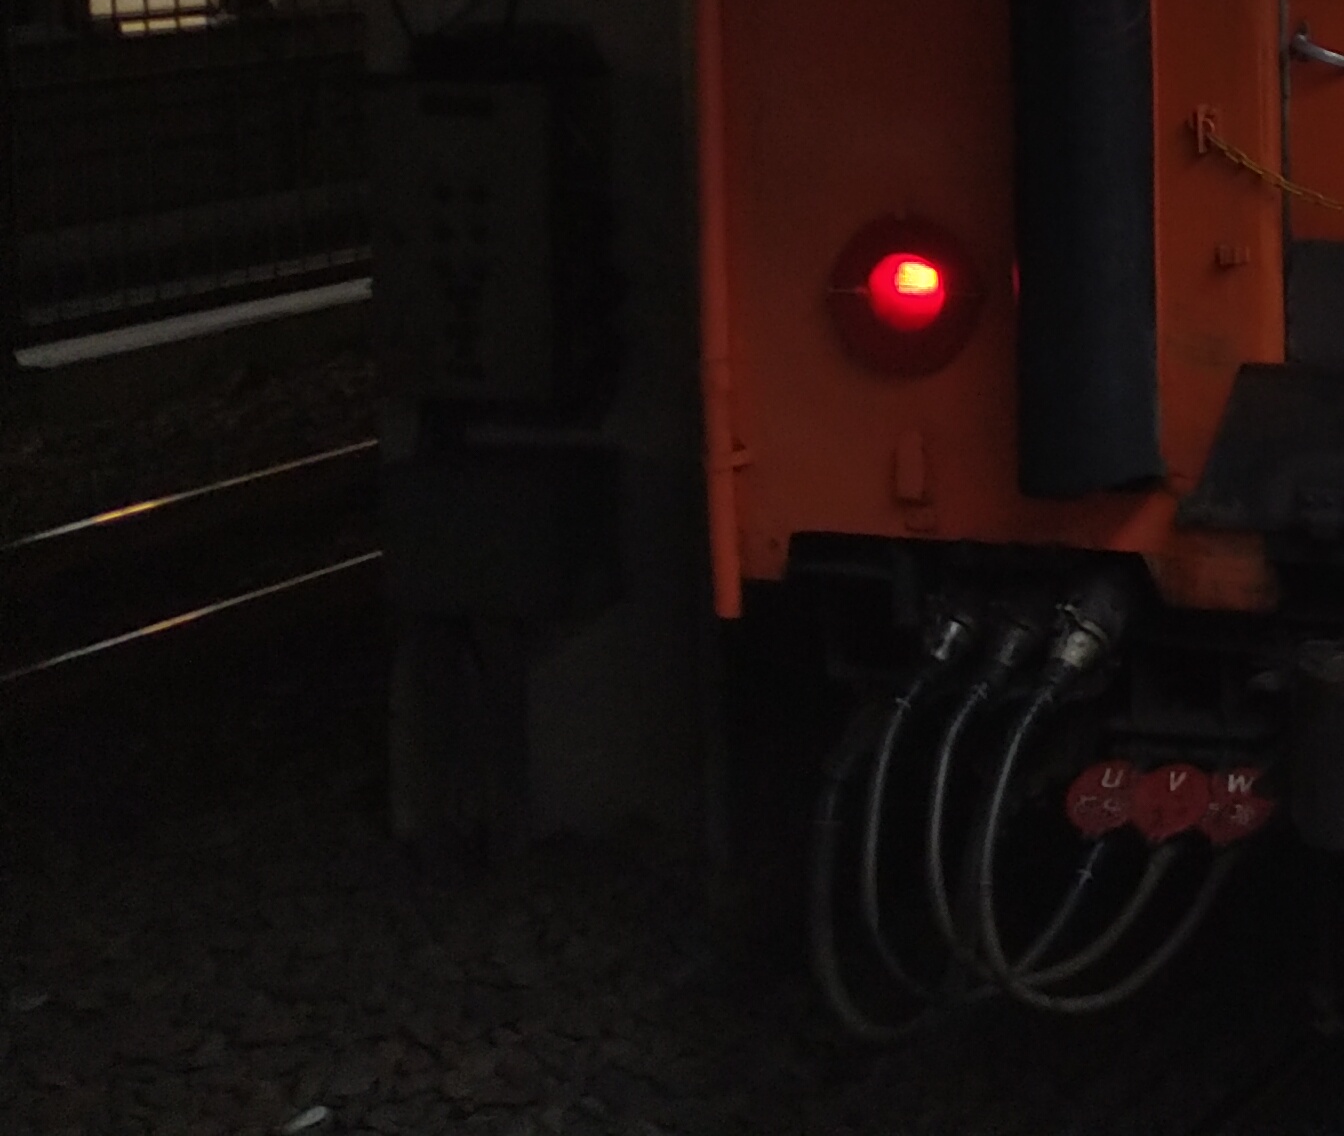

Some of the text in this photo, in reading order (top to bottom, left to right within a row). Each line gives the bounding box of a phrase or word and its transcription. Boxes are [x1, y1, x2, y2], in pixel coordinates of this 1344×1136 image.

[1101, 768, 1255, 793] U V W
